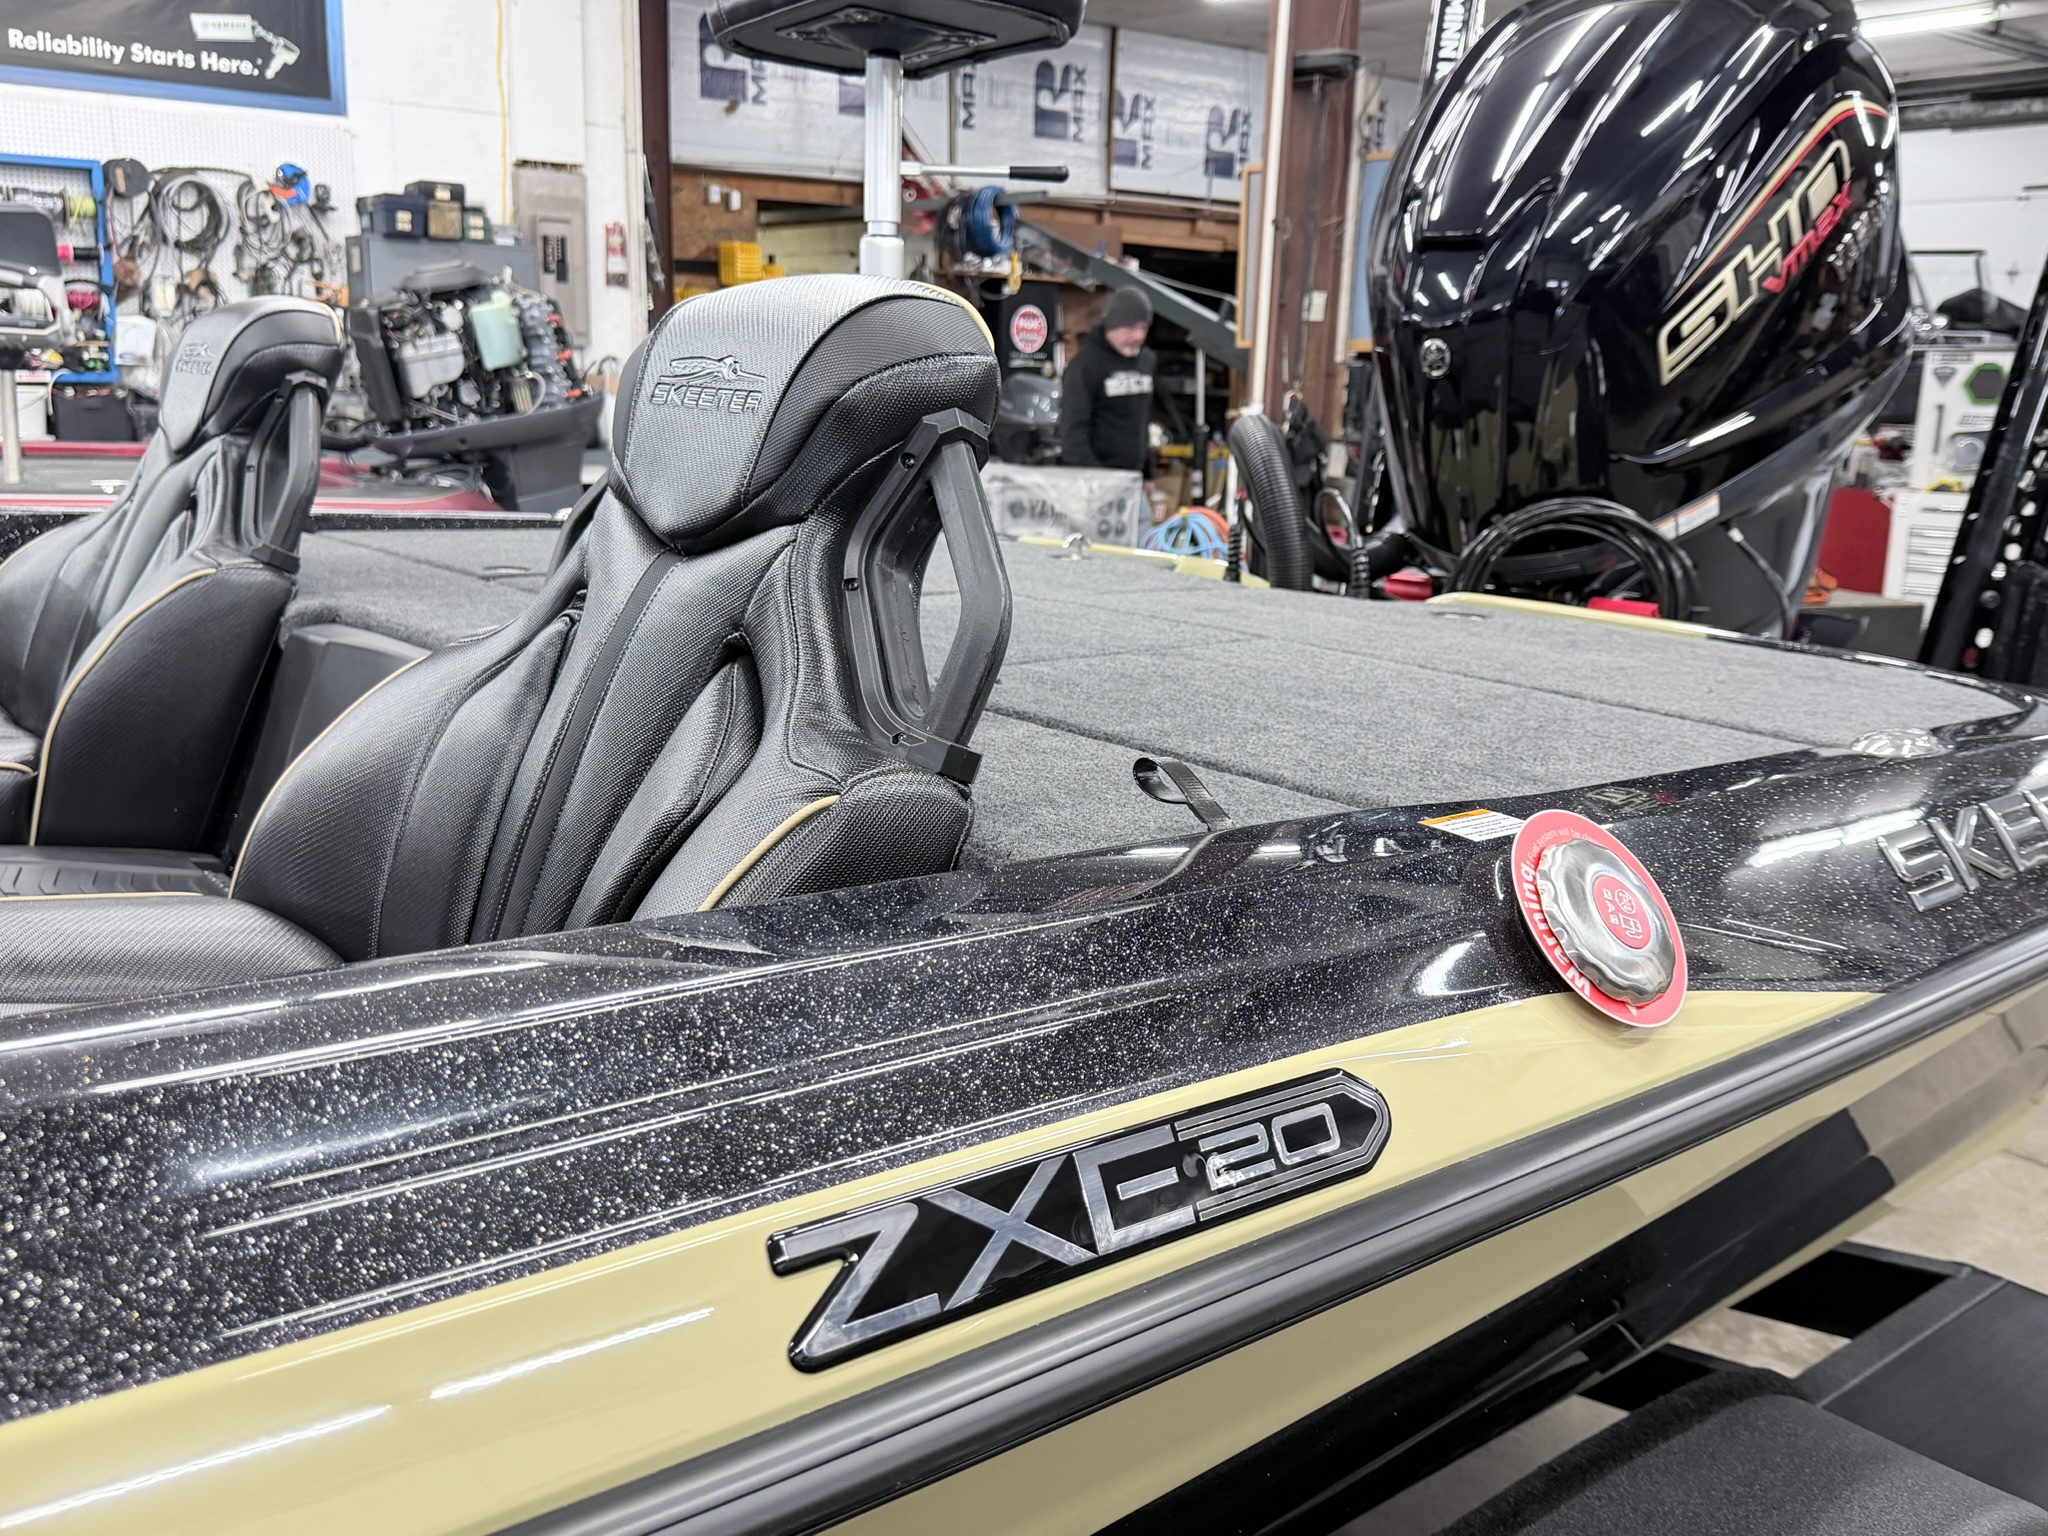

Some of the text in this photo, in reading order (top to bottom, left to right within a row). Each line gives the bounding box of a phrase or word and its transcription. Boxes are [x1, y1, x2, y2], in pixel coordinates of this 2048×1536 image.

[7, 27, 261, 77] Reliability Starts Here.
[962, 64, 977, 130] MA
[650, 382, 762, 414] SKEETER
[1527, 842, 1539, 861] Fuel
[1537, 828, 1558, 848] system
[1569, 828, 1582, 838] be
